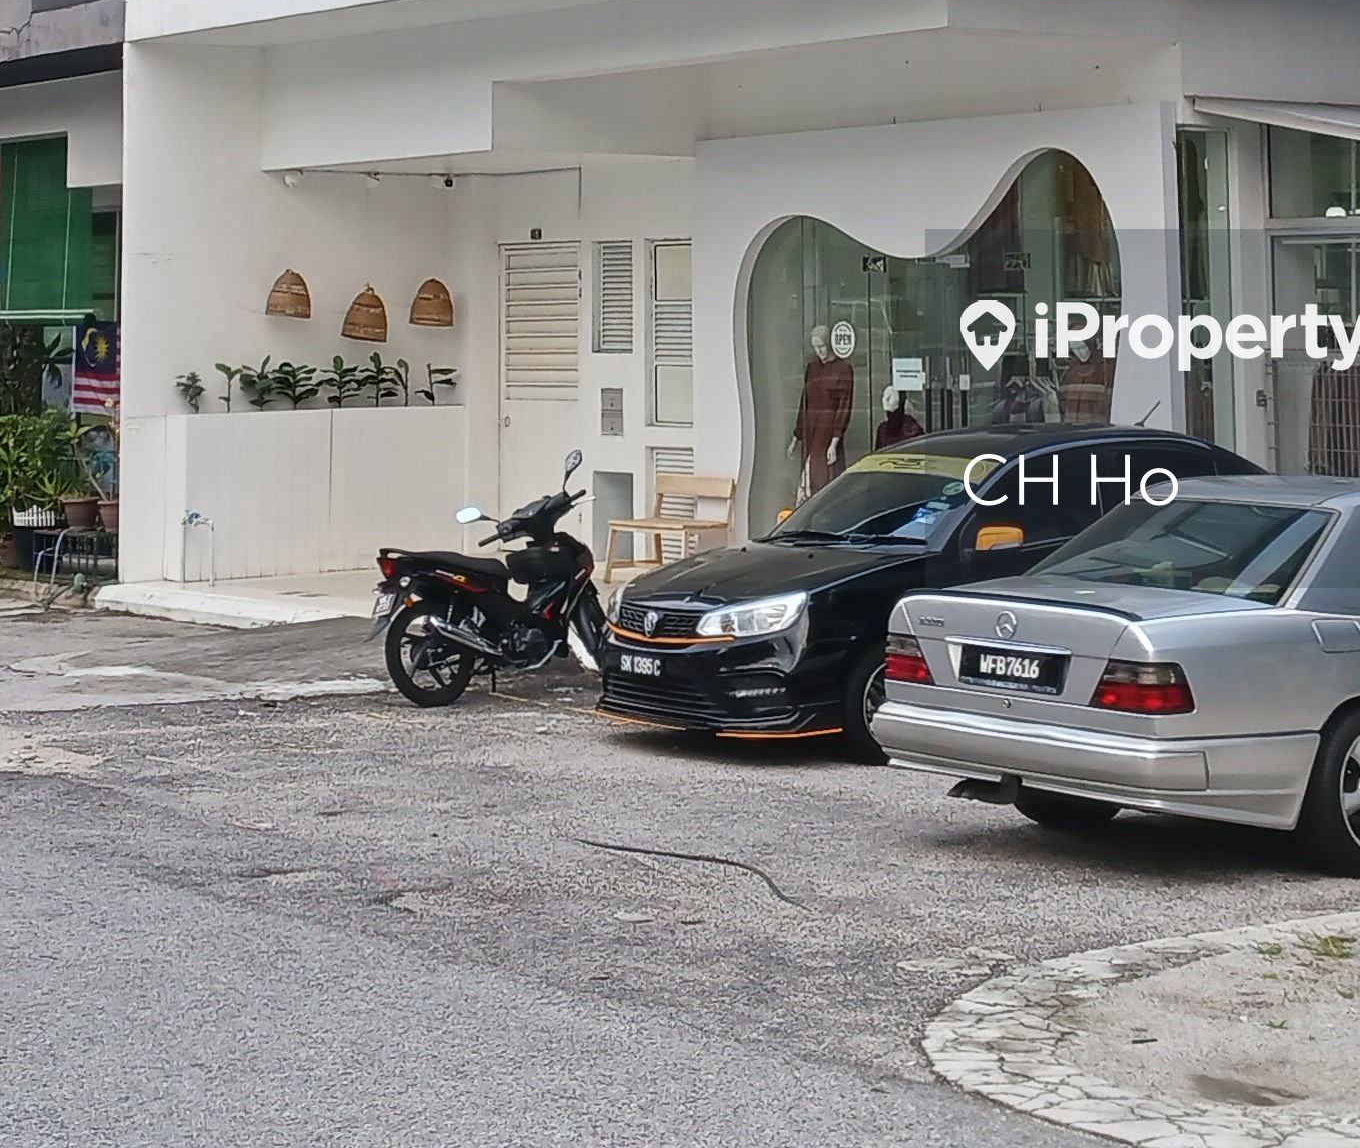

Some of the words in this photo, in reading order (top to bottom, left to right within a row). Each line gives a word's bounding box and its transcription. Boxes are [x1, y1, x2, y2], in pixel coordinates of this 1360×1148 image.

[835, 333, 852, 346] OPEN
[654, 659, 661, 677] C
[979, 653, 1040, 679] WFB7616
